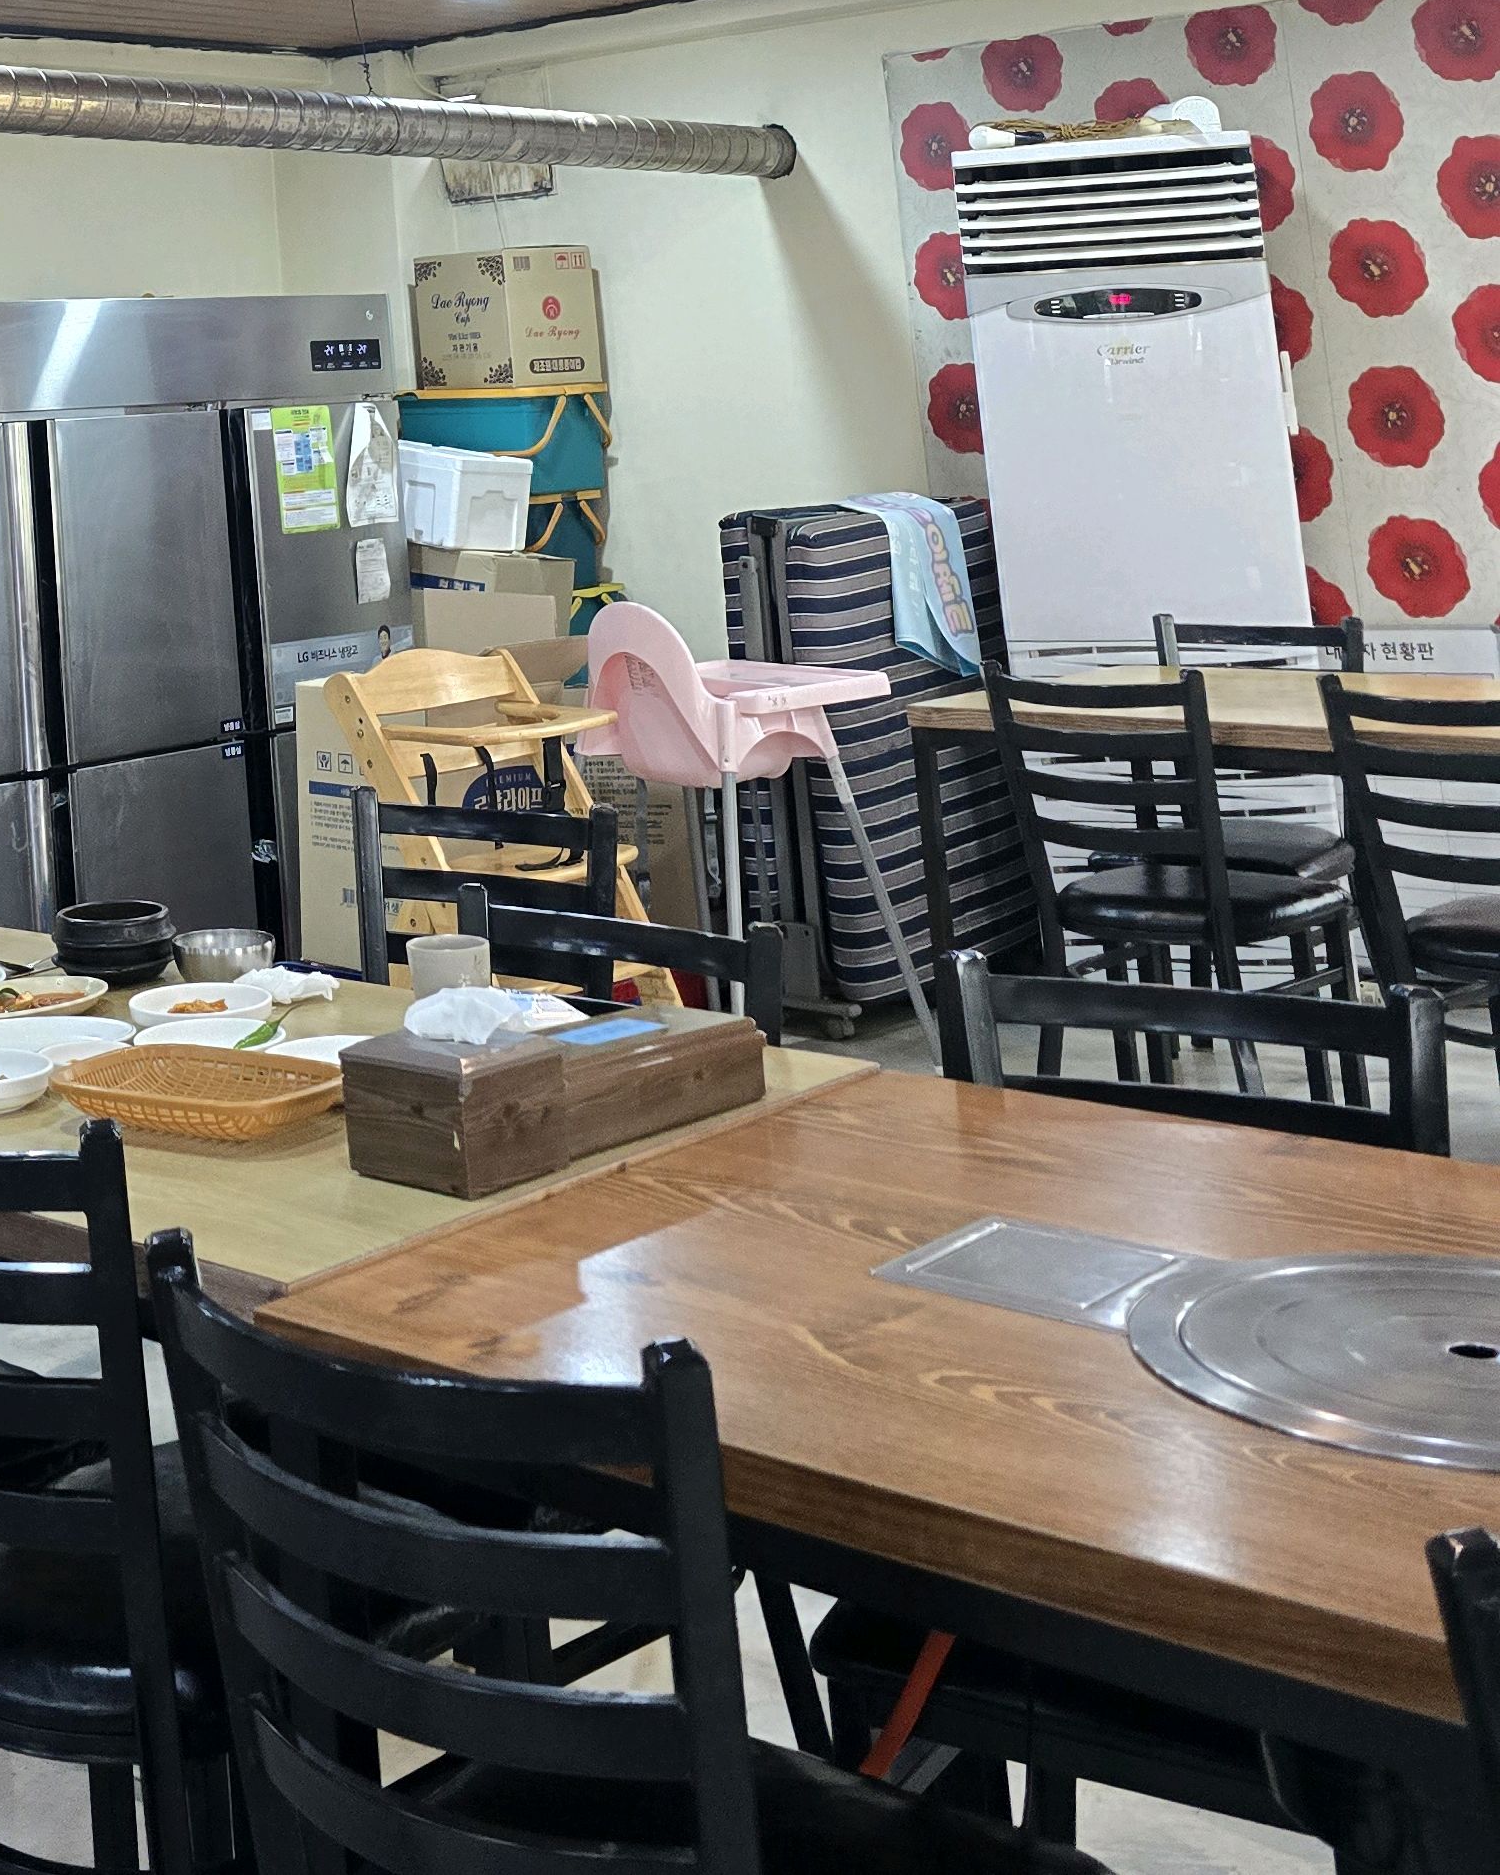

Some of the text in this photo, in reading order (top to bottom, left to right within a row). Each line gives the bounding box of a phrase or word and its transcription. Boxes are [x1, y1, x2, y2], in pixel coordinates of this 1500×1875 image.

[297, 645, 359, 664] LG 비즈니스 냉장고
[1380, 641, 1435, 662] 현황판
